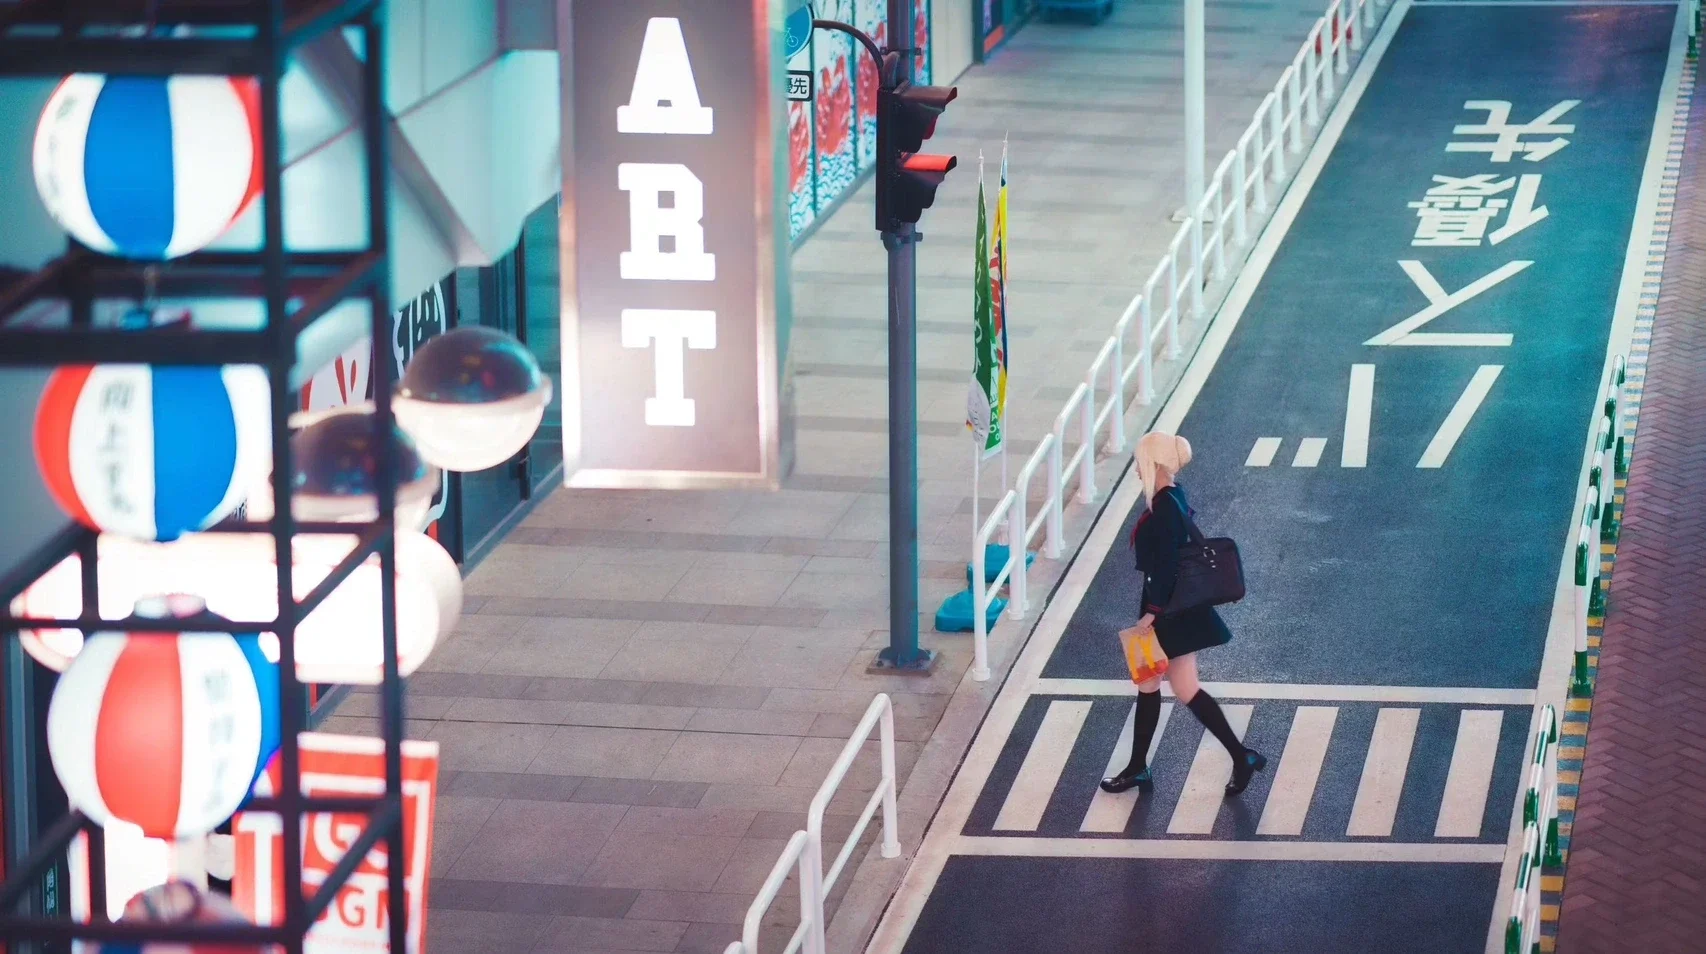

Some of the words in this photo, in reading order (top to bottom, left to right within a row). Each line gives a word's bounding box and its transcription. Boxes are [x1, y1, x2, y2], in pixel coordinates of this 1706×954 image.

[617, 17, 717, 427] ART
[1244, 99, 1583, 469] バス優先
